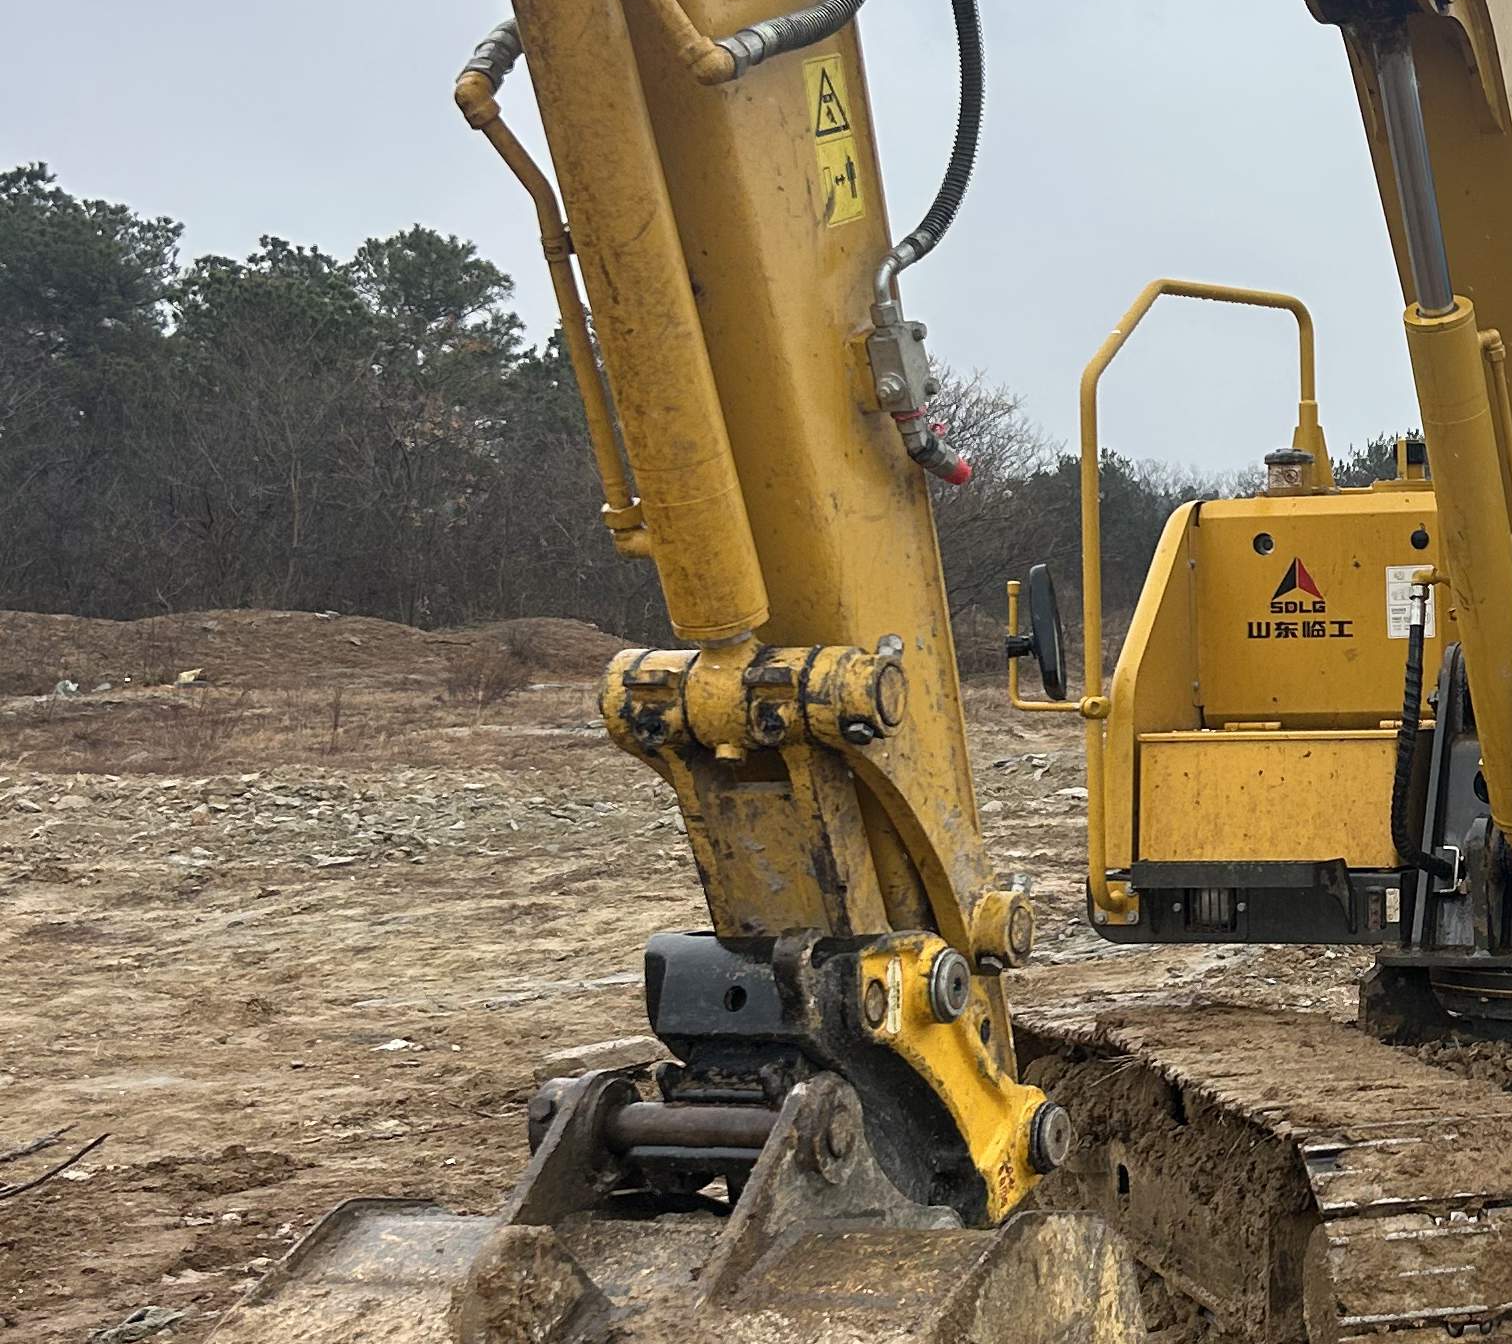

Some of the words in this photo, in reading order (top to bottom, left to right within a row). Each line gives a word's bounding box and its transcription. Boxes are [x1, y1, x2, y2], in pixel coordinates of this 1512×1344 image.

[1270, 601, 1325, 613] SDLG
[1247, 620, 1353, 639] 山东临工
